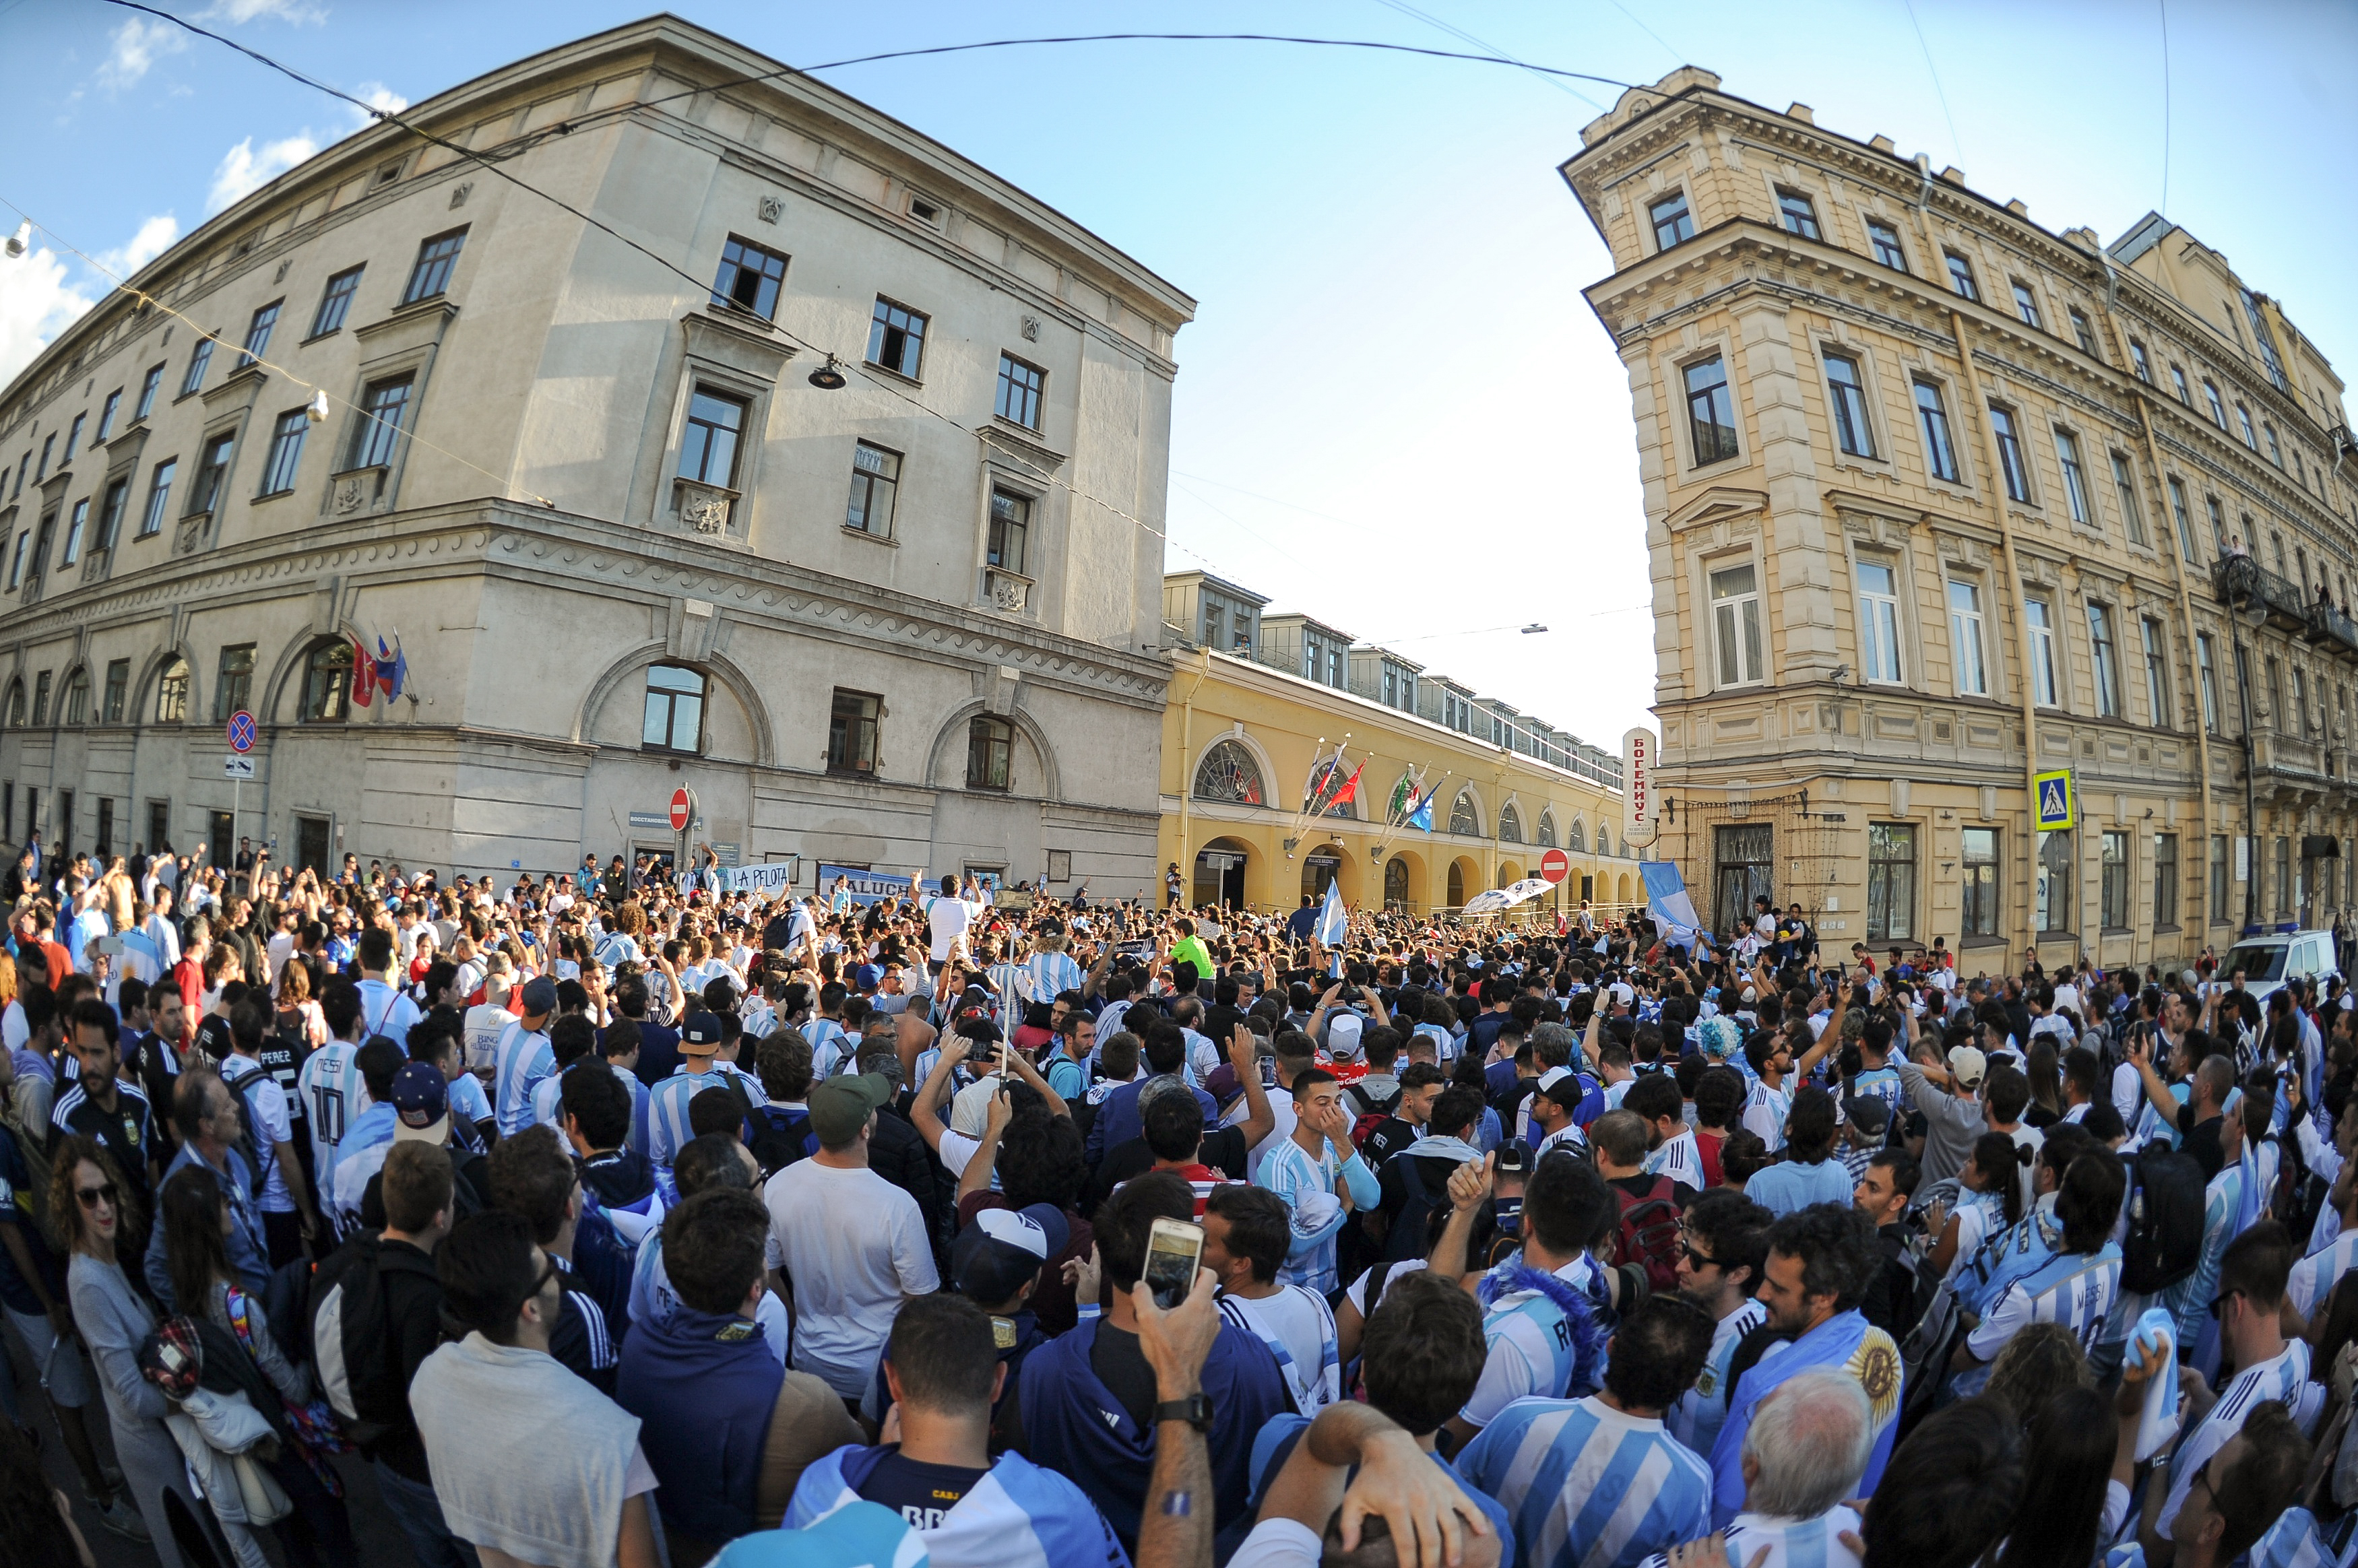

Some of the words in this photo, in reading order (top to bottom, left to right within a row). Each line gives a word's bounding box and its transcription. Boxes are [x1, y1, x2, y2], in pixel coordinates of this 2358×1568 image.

[1634, 738, 1645, 822] БОГЕМИУС
[630, 816, 670, 824] ВОССТАНОВЛЕН
[753, 867, 788, 889] PELOTA
[477, 1034, 499, 1044] BING
[315, 1058, 342, 1074] MESSI
[311, 1084, 345, 1148] 10
[2076, 1281, 2105, 1311] MESSI
